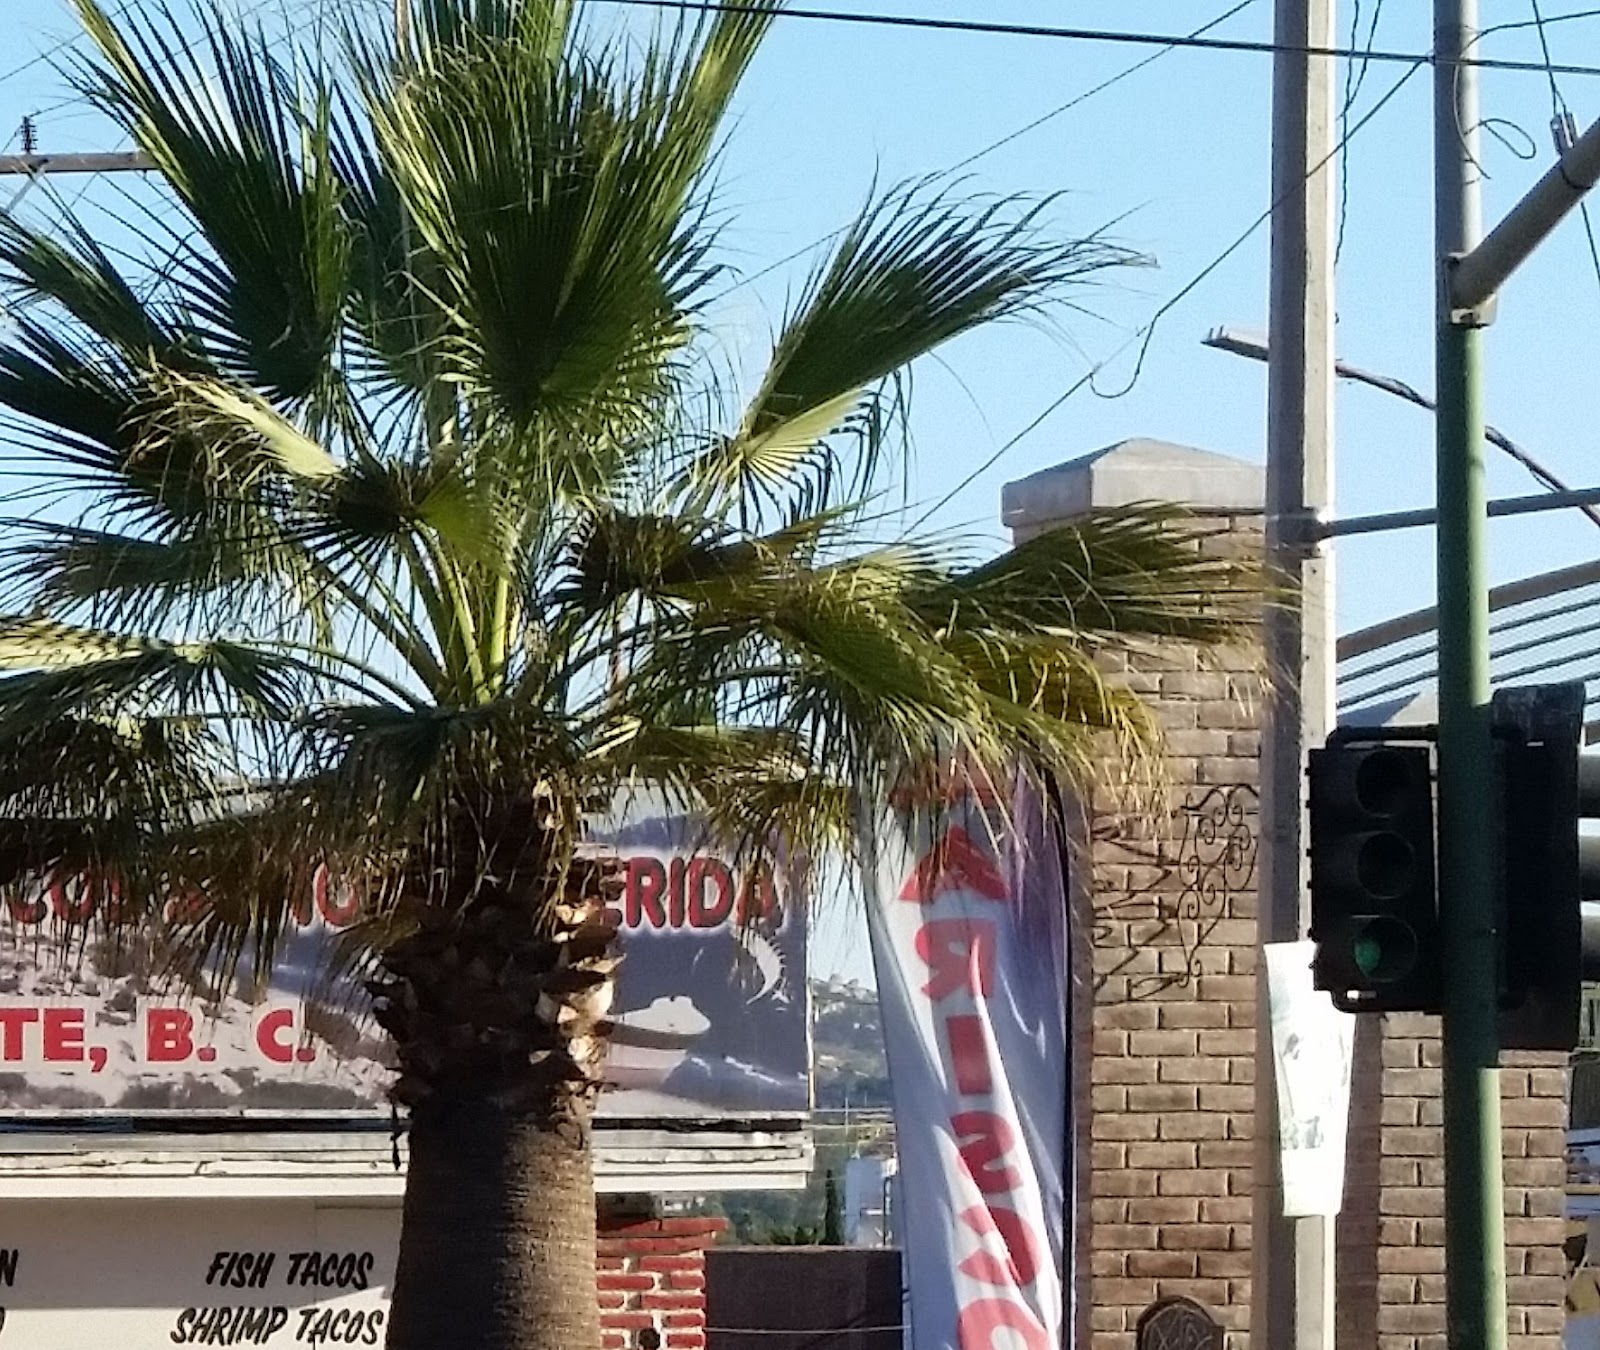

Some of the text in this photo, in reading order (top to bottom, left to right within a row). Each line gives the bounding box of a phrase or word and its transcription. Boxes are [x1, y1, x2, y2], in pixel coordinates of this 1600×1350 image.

[147, 1008, 217, 1062] B.
[256, 1009, 316, 1062] C.
[206, 1252, 373, 1290] FISH TACOS
[170, 1306, 384, 1345] SHRIMP TACOS
